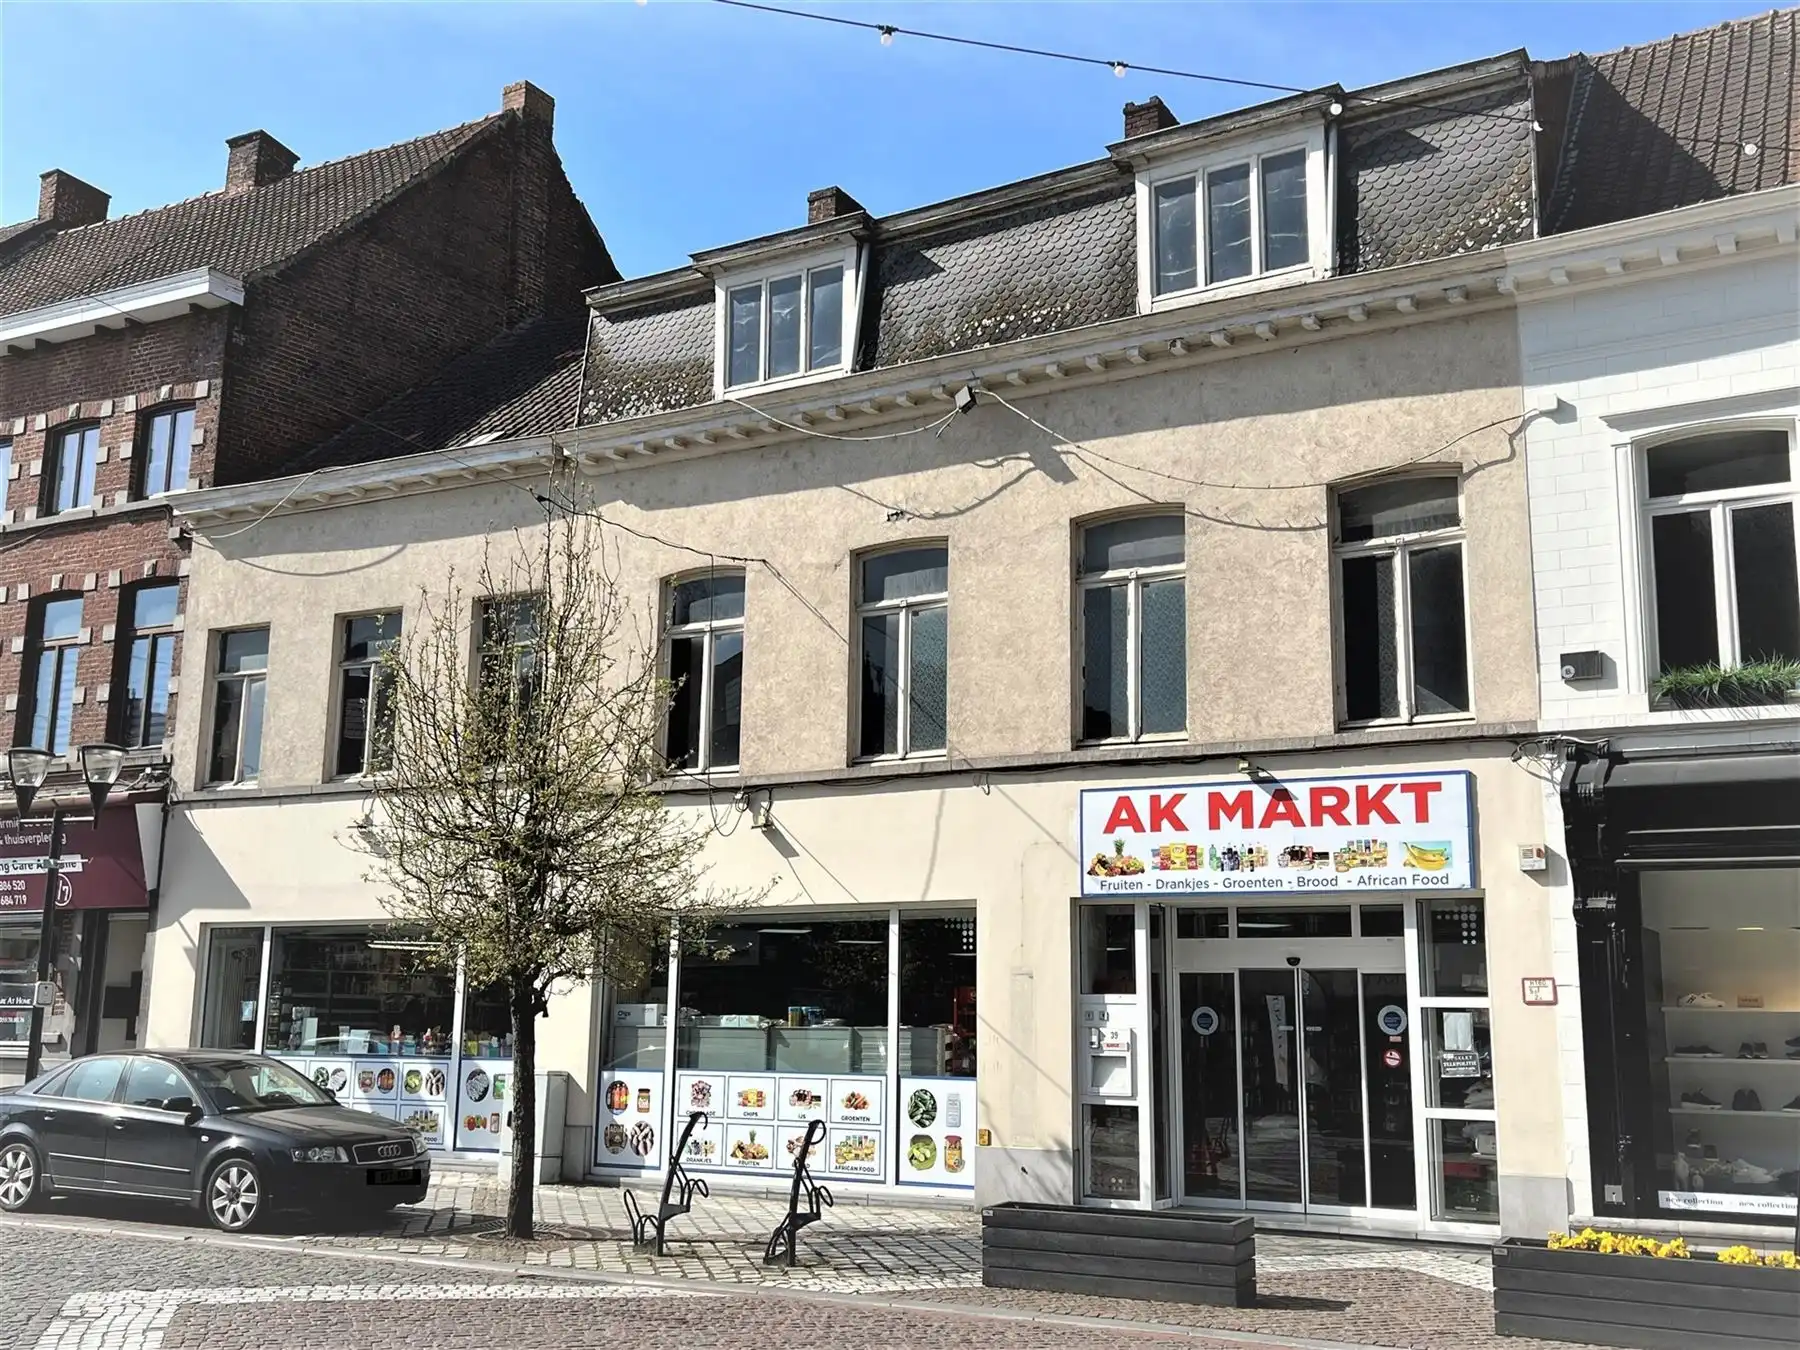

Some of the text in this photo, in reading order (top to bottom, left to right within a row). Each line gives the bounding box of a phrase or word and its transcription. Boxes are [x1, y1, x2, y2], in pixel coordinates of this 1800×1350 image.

[1103, 781, 1442, 835] AK MARKT
[12, 880, 26, 891] 520
[1100, 880, 1143, 891] Fruiten
[1156, 878, 1210, 891] Drankjes
[1222, 877, 1283, 888] Groenten
[1297, 875, 1338, 887] Brood
[1357, 874, 1407, 886] African
[1412, 873, 1449, 885] Food
[1, 894, 27, 906] 684 719
[1110, 1031, 1118, 1039] 39
[1682, 1197, 1724, 1205] collection
